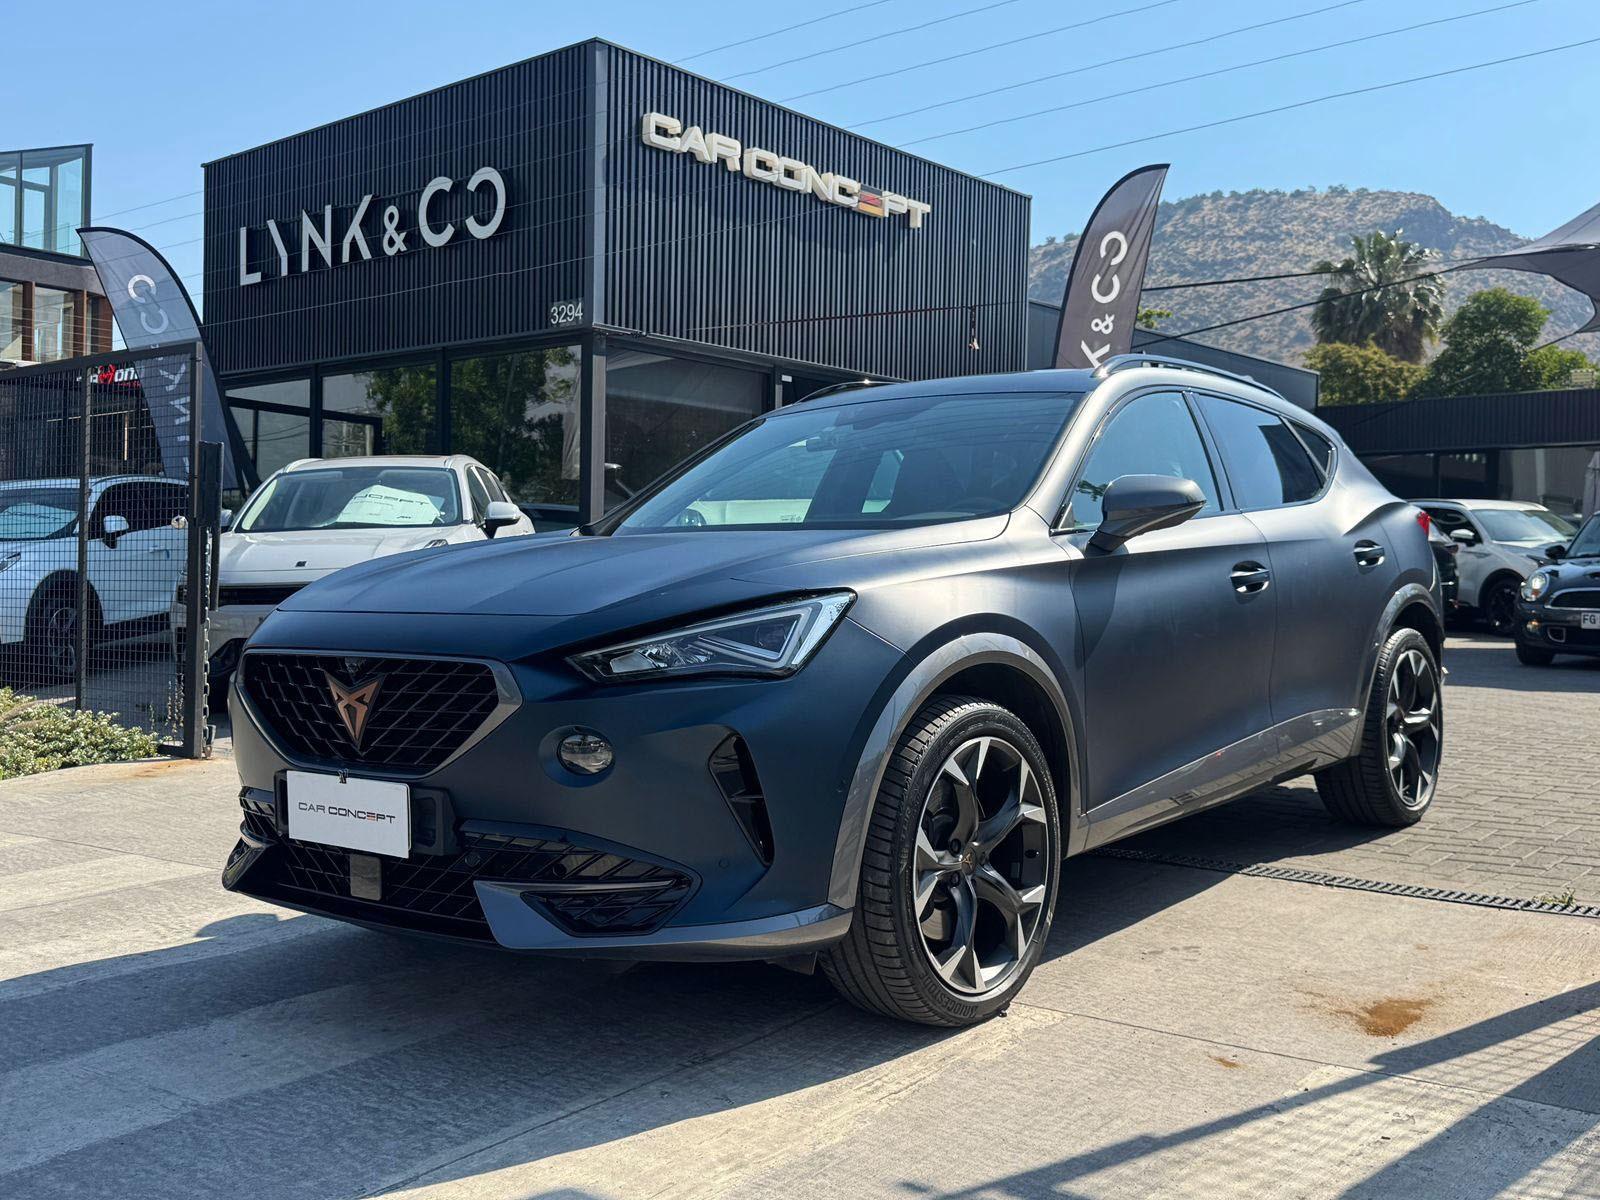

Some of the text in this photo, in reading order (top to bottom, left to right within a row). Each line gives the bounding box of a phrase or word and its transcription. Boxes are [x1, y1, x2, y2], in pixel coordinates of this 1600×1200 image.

[642, 112, 931, 228] CAR CONCEPT
[551, 302, 583, 324] 3294
[299, 802, 396, 824] CAR CONCEPT
